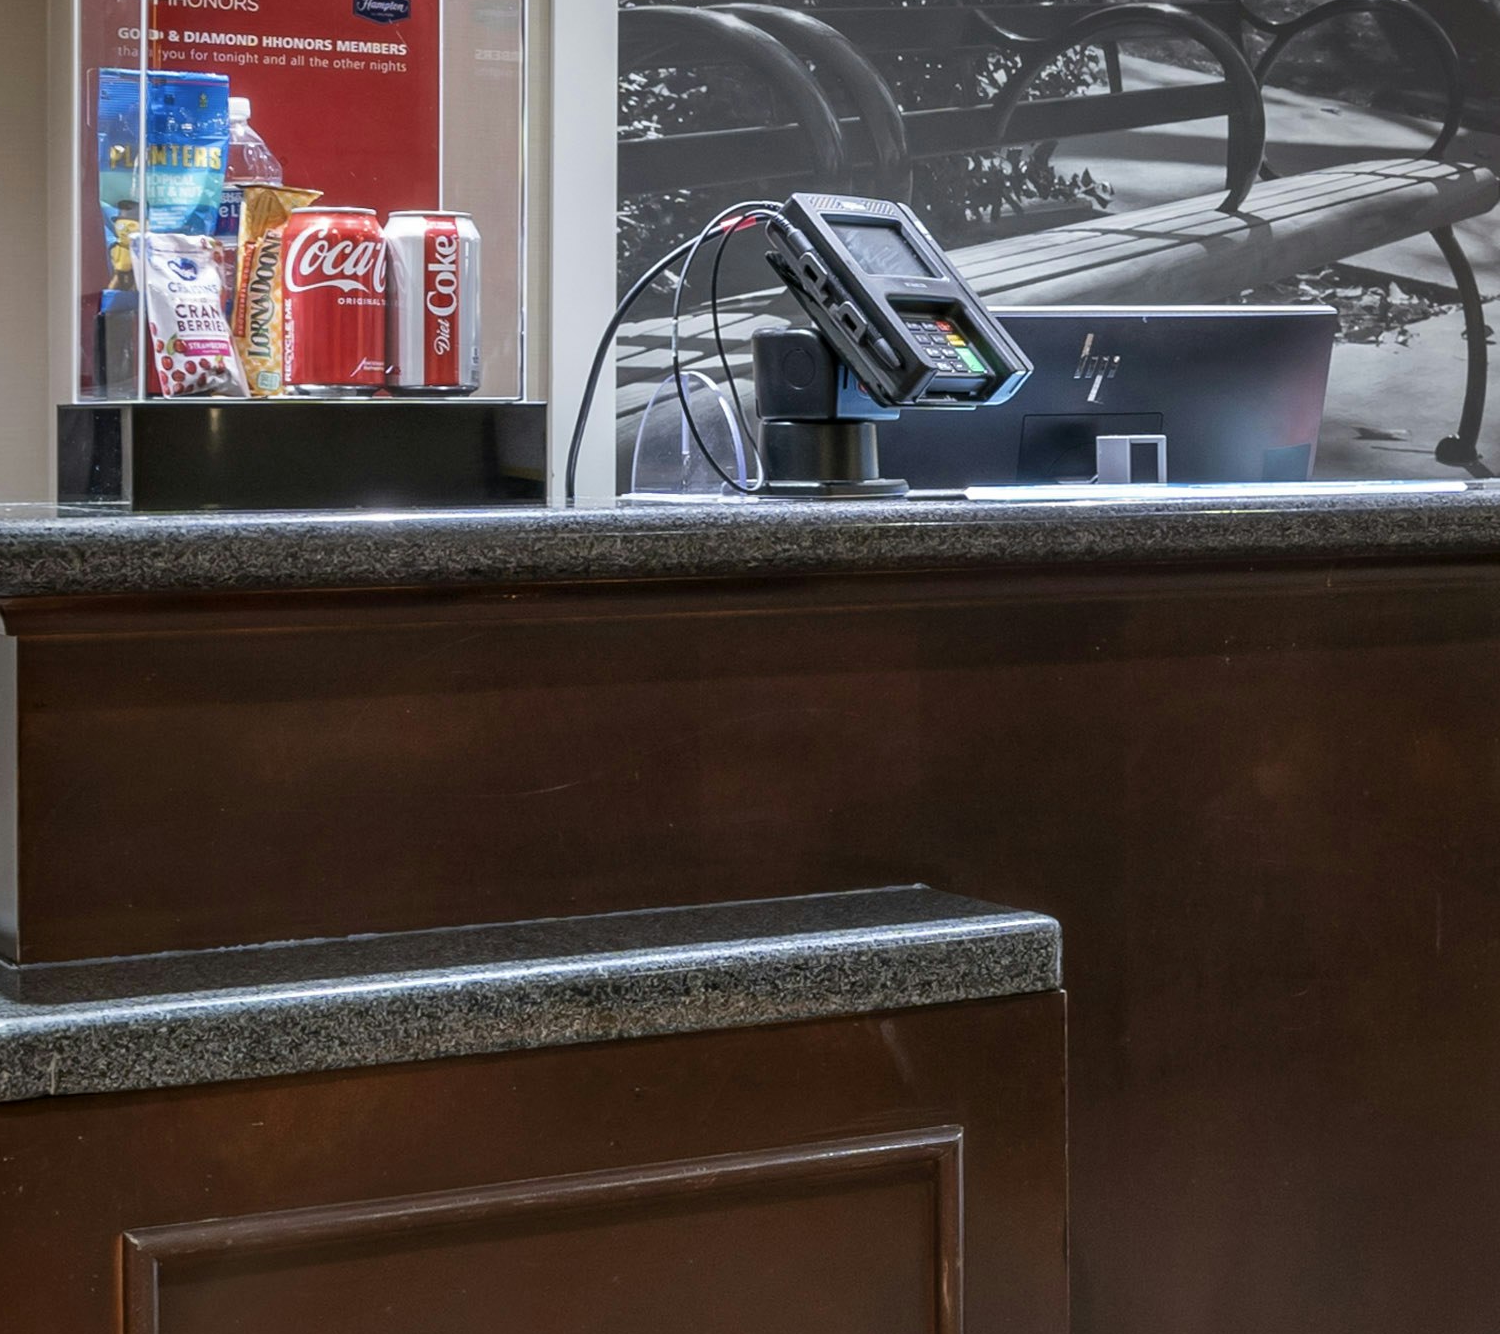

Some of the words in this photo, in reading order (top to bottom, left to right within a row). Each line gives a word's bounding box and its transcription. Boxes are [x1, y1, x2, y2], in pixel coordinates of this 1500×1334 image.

[118, 27, 164, 41] GOD
[168, 29, 179, 42] &
[184, 31, 258, 47] DIAMOND
[262, 35, 333, 52] HHONORS
[336, 40, 407, 55] MEMBERS
[162, 49, 186, 61] you
[190, 48, 209, 61] for
[213, 51, 259, 66] tonight
[263, 53, 286, 66] and
[290, 53, 305, 66] all
[309, 54, 329, 68] the
[332, 56, 365, 70] other
[369, 59, 407, 74] nights
[110, 143, 222, 171] PLNTERS
[250, 229, 282, 296] DOONE
[426, 235, 458, 317] Coke
[175, 303, 220, 319] CRAN
[284, 297, 293, 319] ME
[248, 293, 275, 358] LORNA
[284, 320, 295, 382] RECYCLE
